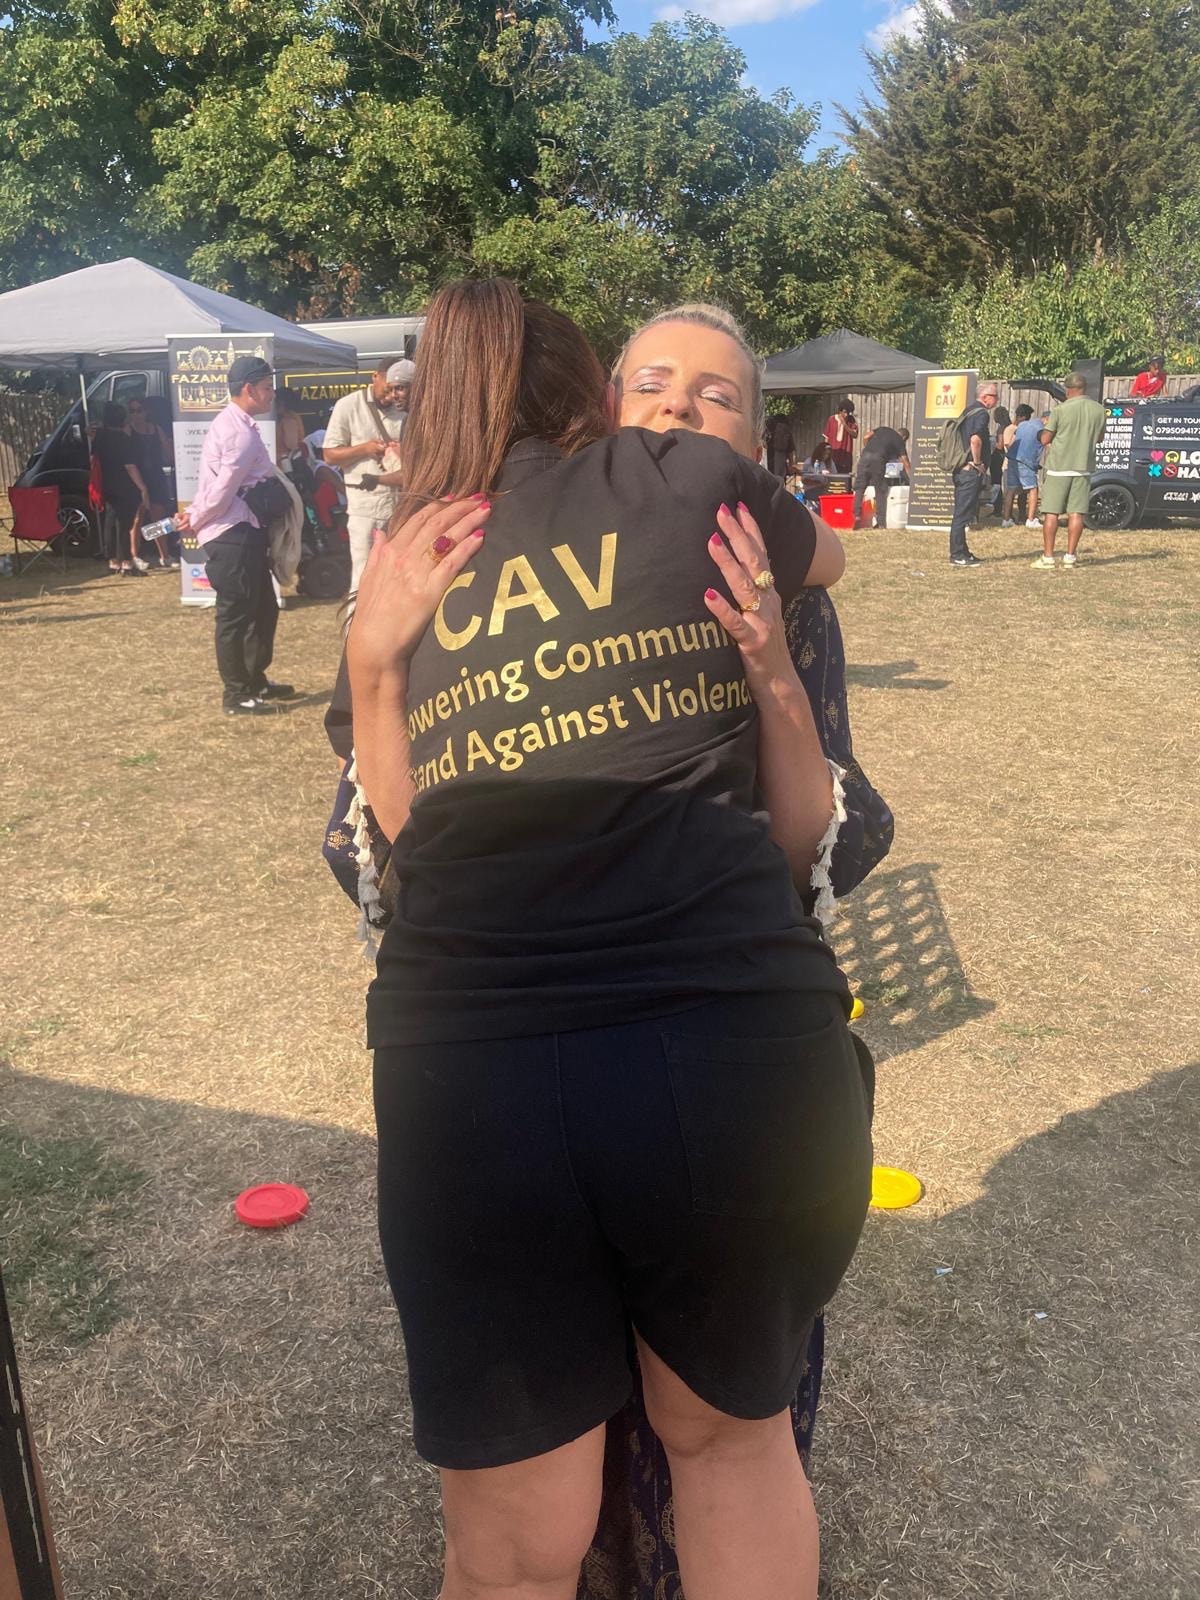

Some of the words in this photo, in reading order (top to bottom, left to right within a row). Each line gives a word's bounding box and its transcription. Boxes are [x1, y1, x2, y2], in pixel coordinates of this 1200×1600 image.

[935, 394, 956, 406] CAV
[1177, 466, 1200, 479] HA
[433, 532, 618, 652] CAV
[467, 694, 629, 772] Against
[631, 671, 752, 723] Violenc
